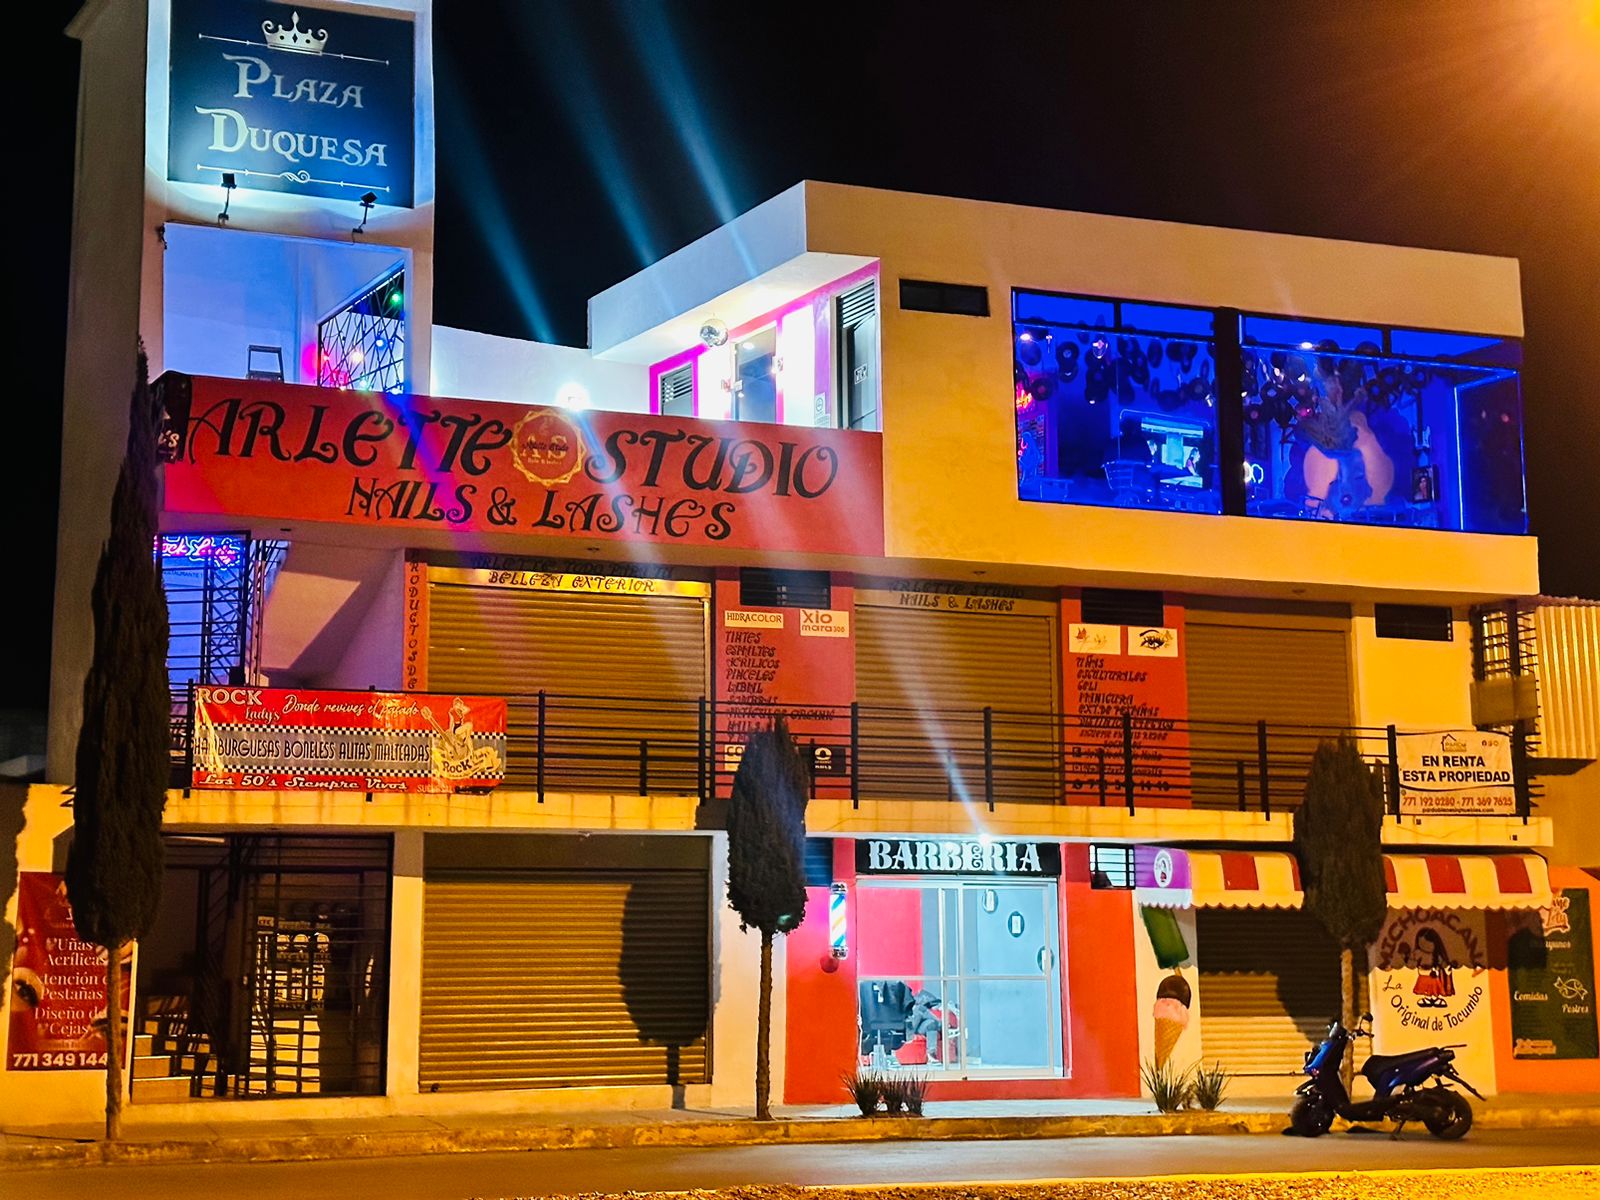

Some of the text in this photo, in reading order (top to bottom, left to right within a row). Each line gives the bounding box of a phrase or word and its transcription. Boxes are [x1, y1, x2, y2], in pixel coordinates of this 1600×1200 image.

[222, 53, 364, 108] PLAZA
[195, 105, 388, 167] DUQUESA
[584, 429, 839, 499] STUDIO
[344, 477, 736, 541] NAILS & LASHES
[488, 570, 655, 593] BELLEZA EXTERIOR
[900, 593, 1015, 612] NAILS & LASHES
[726, 611, 782, 624] HIDRACOLOR
[725, 631, 762, 644] TINTES
[726, 668, 777, 682] PINCELES
[197, 687, 263, 706] ROCK
[282, 694, 321, 714] Donde
[284, 740, 336, 761] BONELESS
[339, 742, 372, 761] ALITAS
[374, 743, 431, 763] MALTEADAS
[1421, 755, 1486, 767] EN RENTA
[199, 773, 235, 785] Los
[241, 774, 278, 787] 50's
[284, 775, 360, 791] Siempre
[365, 777, 408, 790] Vivos
[1402, 770, 1511, 783] ESTA PROPIEDAD
[1403, 796, 1417, 806] 771
[1420, 796, 1433, 807] 192
[1461, 796, 1475, 807] 771
[867, 839, 1043, 872] BARBERIA
[57, 937, 94, 951] Uñas
[1383, 974, 1403, 992] La
[41, 986, 104, 1000] Pestañas
[34, 1006, 85, 1020] Diseño
[1391, 994, 1430, 1031] Original
[1431, 1016, 1444, 1032] de
[1443, 985, 1483, 1029] Tocumbo
[49, 1022, 89, 1037] Cejas
[13, 1053, 38, 1068] 771
[42, 1053, 75, 1067] 349
